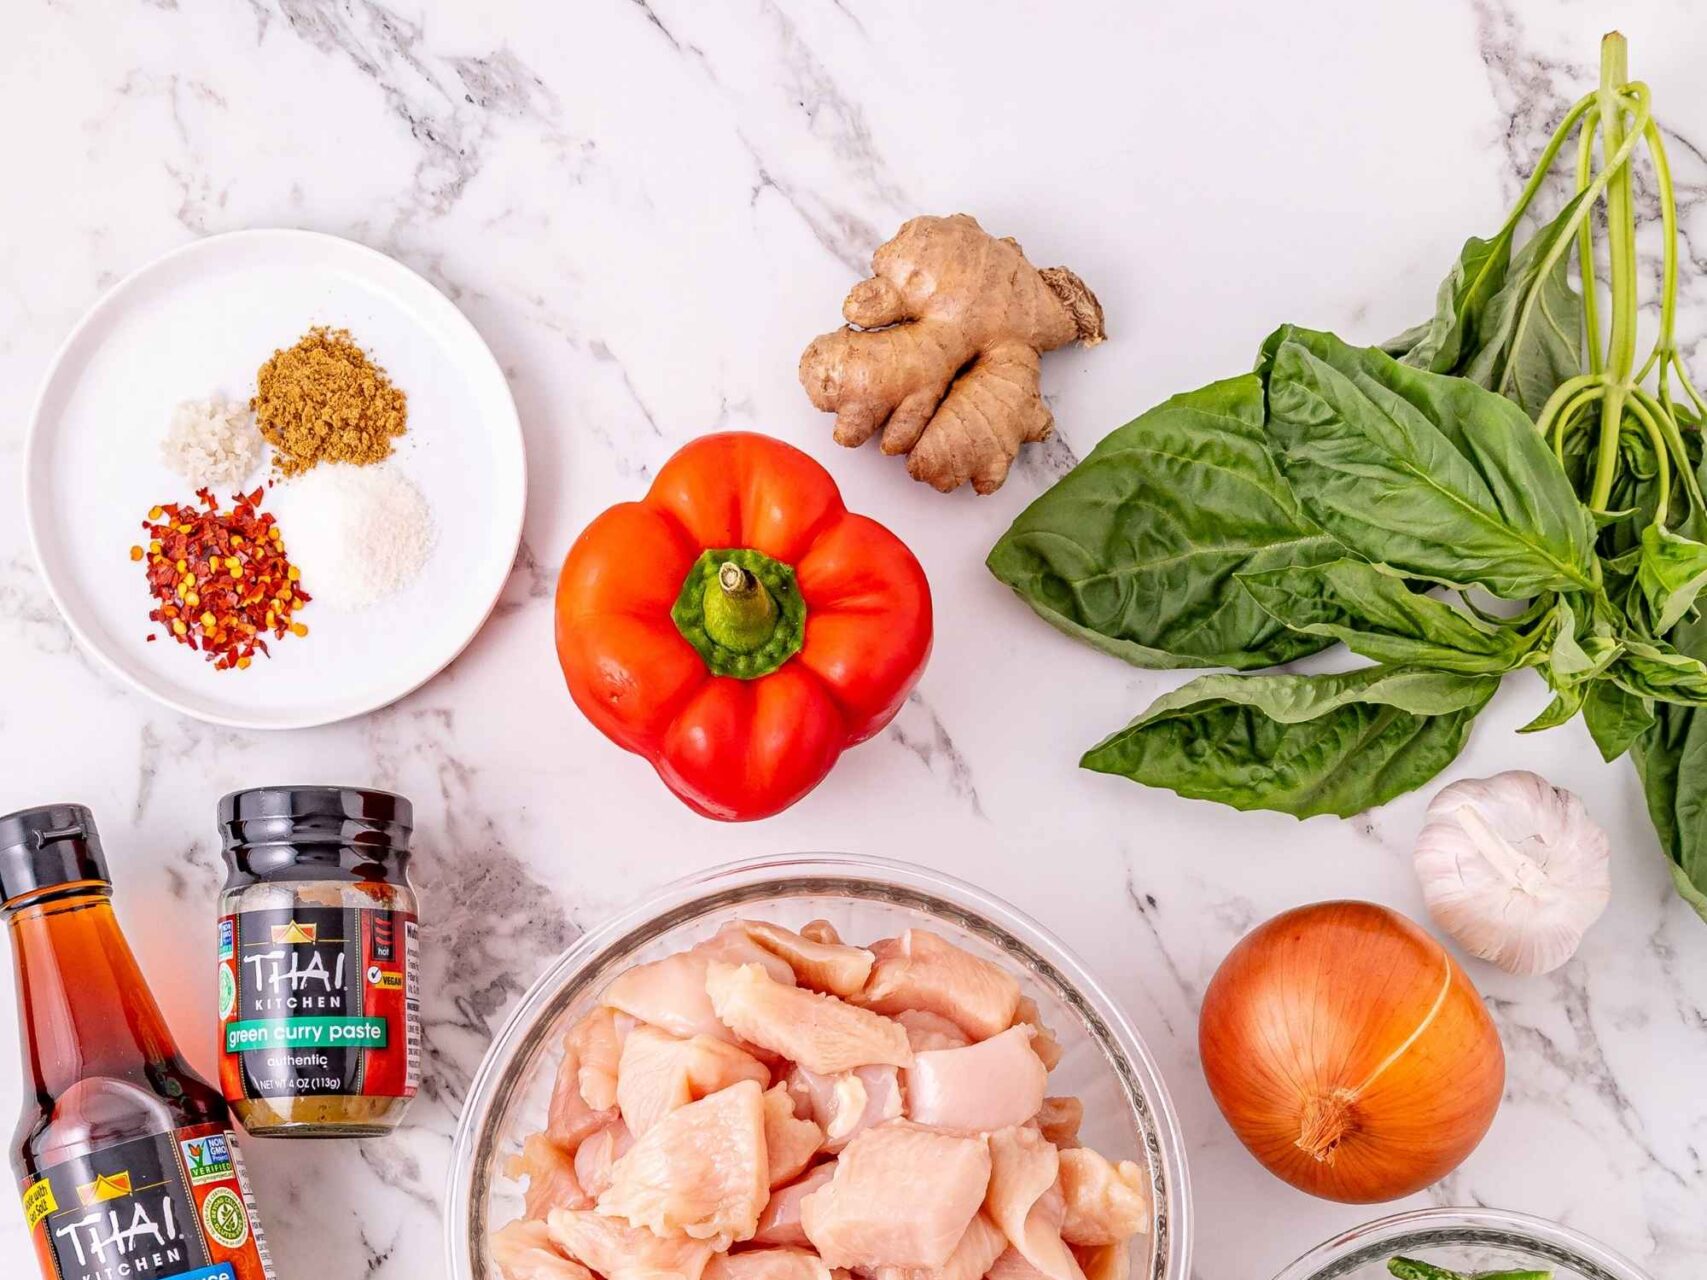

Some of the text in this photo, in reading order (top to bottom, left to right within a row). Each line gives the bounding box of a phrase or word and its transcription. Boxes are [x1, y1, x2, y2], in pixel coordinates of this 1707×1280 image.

[377, 947, 389, 956] hot
[243, 950, 345, 994] THAI
[383, 975, 402, 986] VEGAN
[255, 996, 341, 1011] KITCHEN
[229, 1022, 382, 1048] green curry paste
[267, 1054, 328, 1067] authentic
[260, 1078, 341, 1090] NET WT 4 OZ (113g)
[208, 1138, 225, 1147] NON
[210, 1146, 227, 1155] GMO
[192, 1162, 232, 1176] VERIFIED
[55, 1195, 176, 1267] THAI
